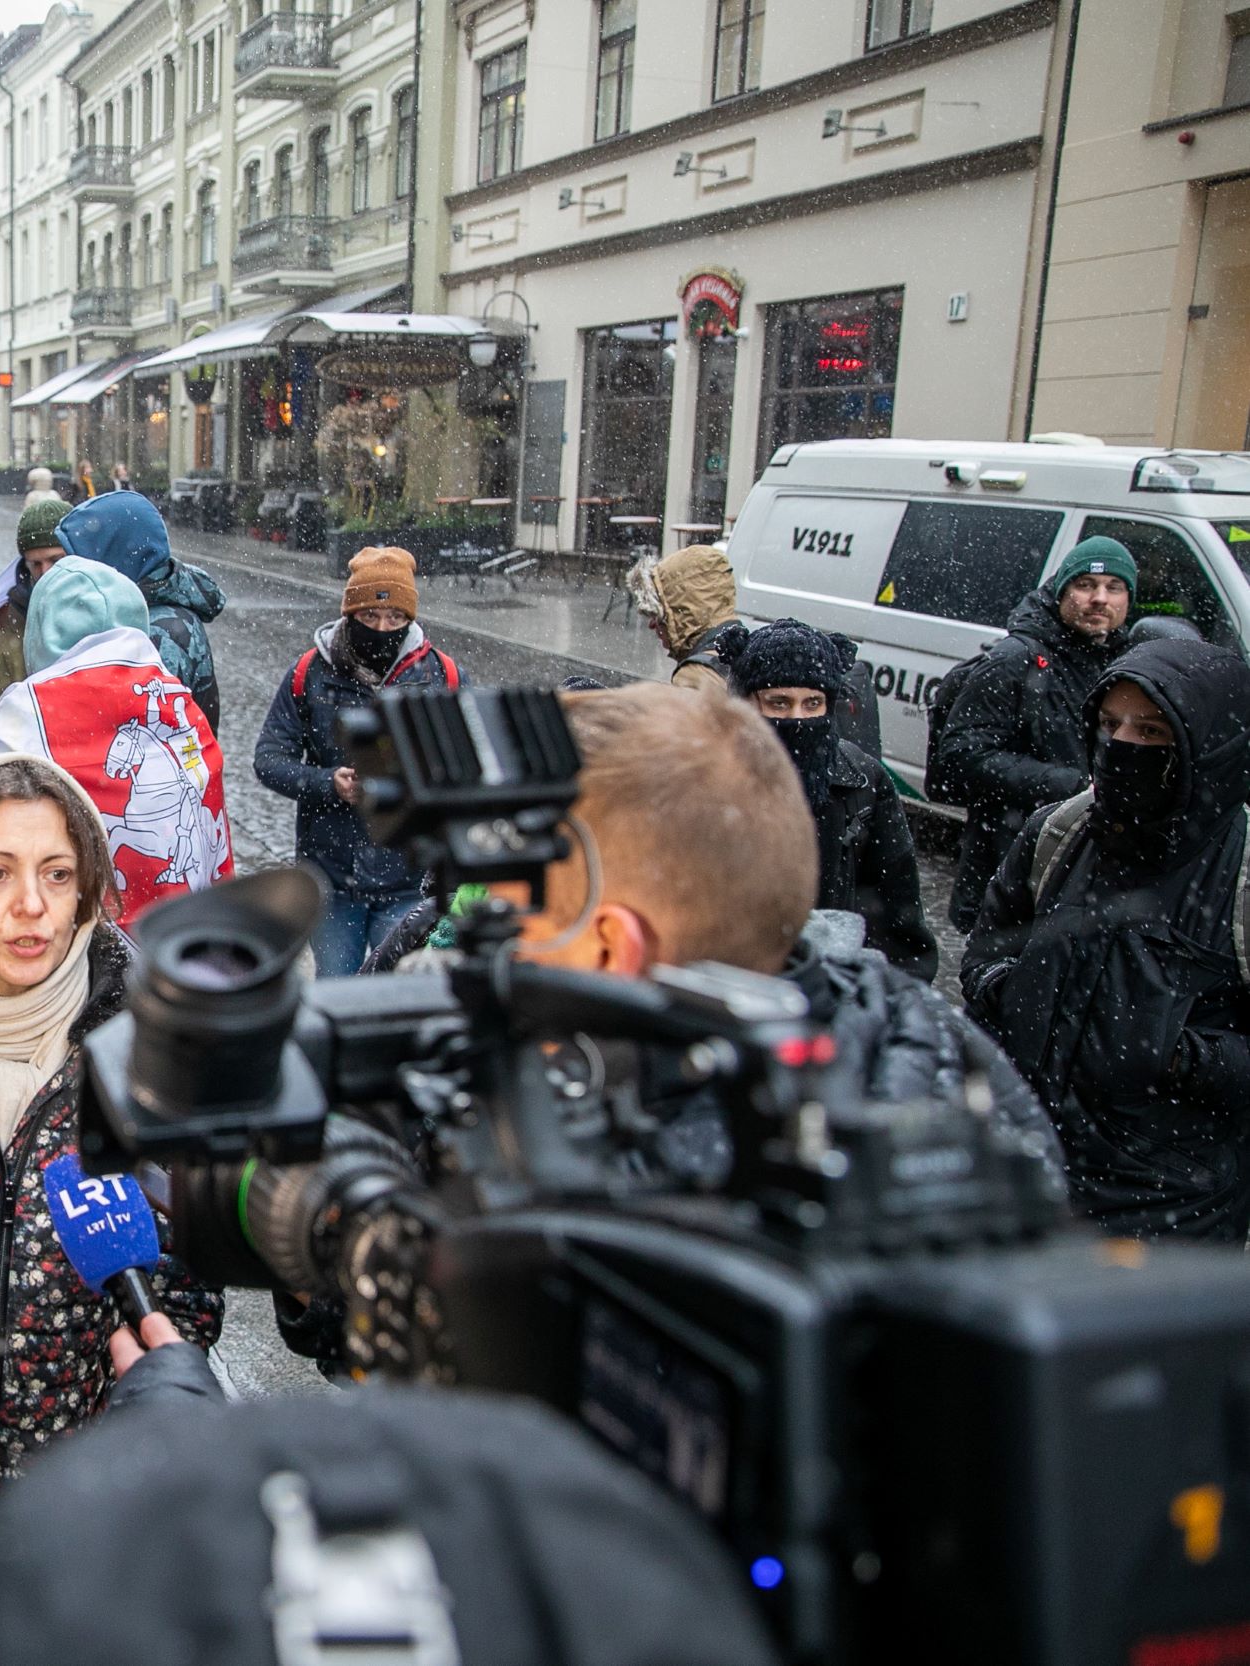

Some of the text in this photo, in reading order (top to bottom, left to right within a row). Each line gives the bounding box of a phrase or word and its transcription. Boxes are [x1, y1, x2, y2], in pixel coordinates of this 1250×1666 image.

[792, 526, 854, 557] V1911
[59, 1173, 128, 1219] LRT
[115, 1212, 131, 1225] TV
